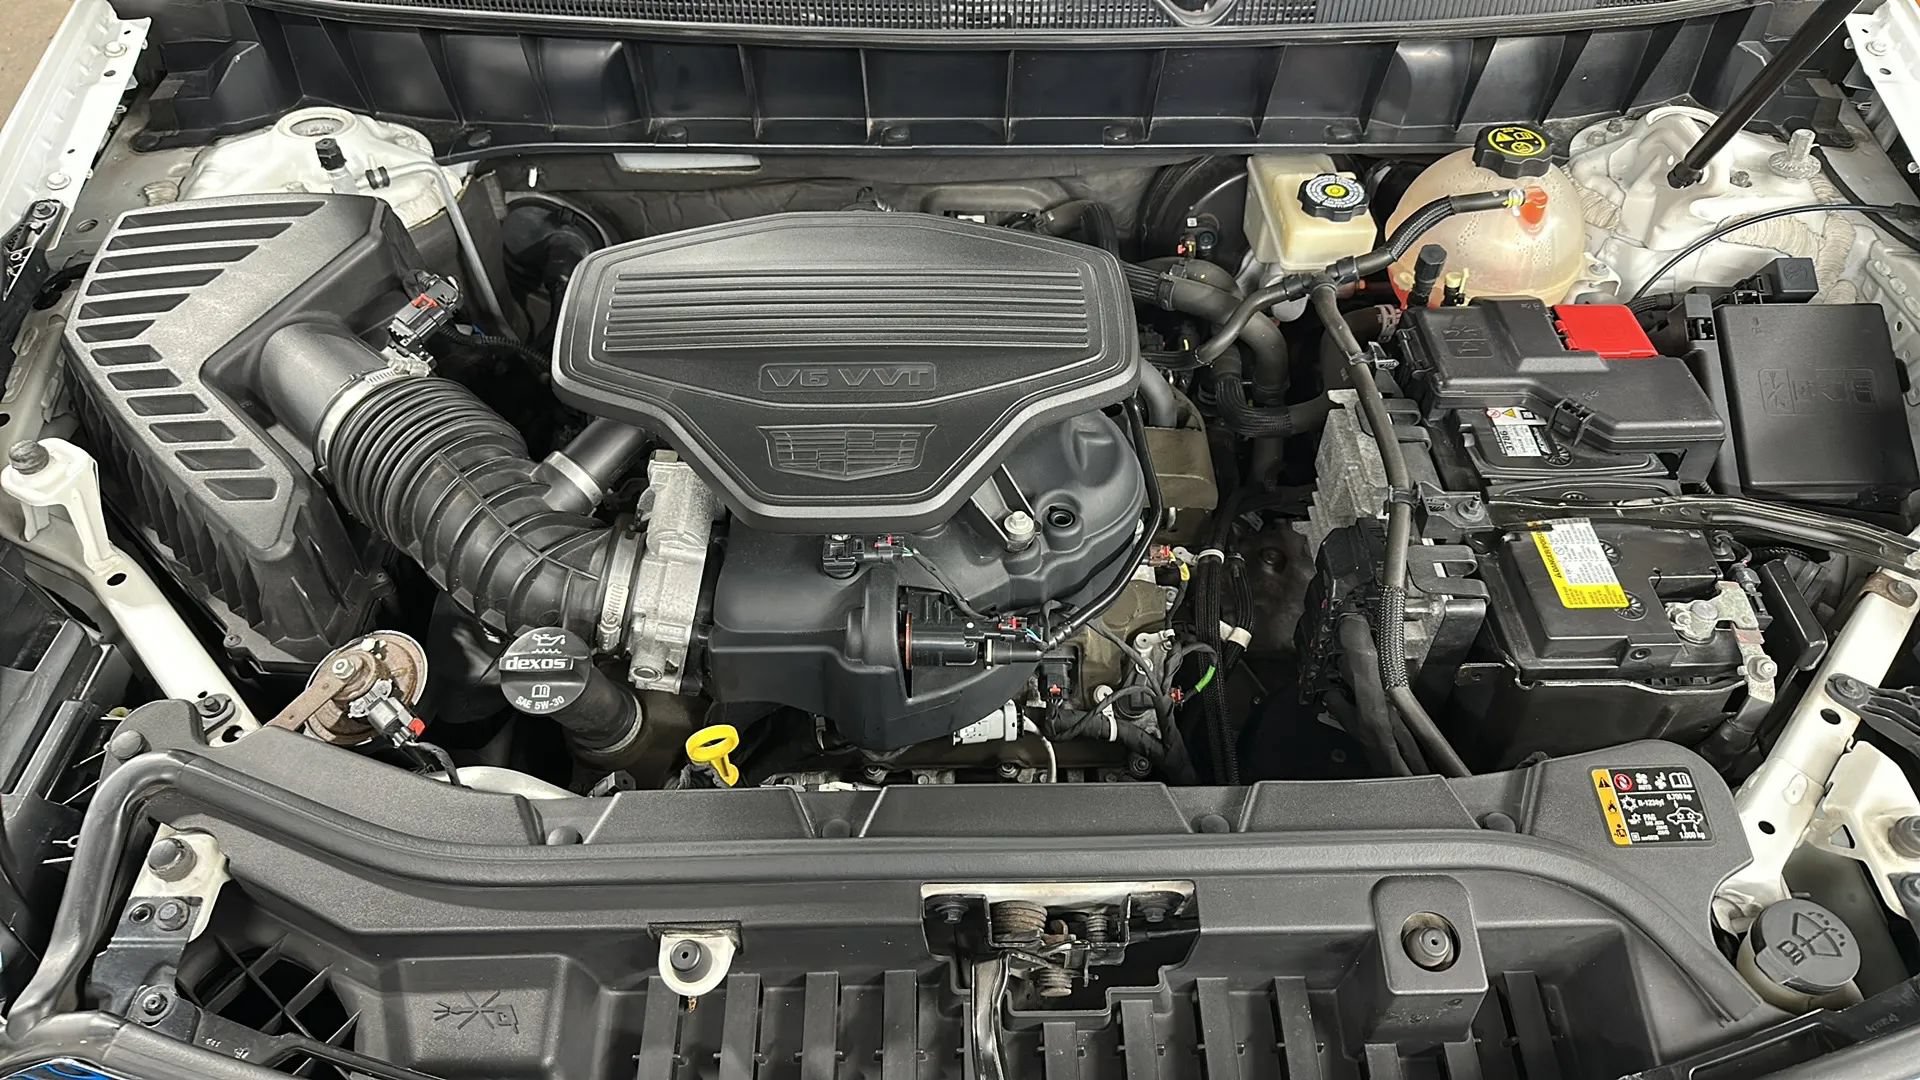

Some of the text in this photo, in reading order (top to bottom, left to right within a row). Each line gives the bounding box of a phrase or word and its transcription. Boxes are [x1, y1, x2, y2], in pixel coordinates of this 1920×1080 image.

[767, 368, 928, 387] V6 VVT
[1499, 430, 1515, 451] 3786
[505, 656, 568, 670] dexos
[516, 695, 565, 710] SAE 5W-30
